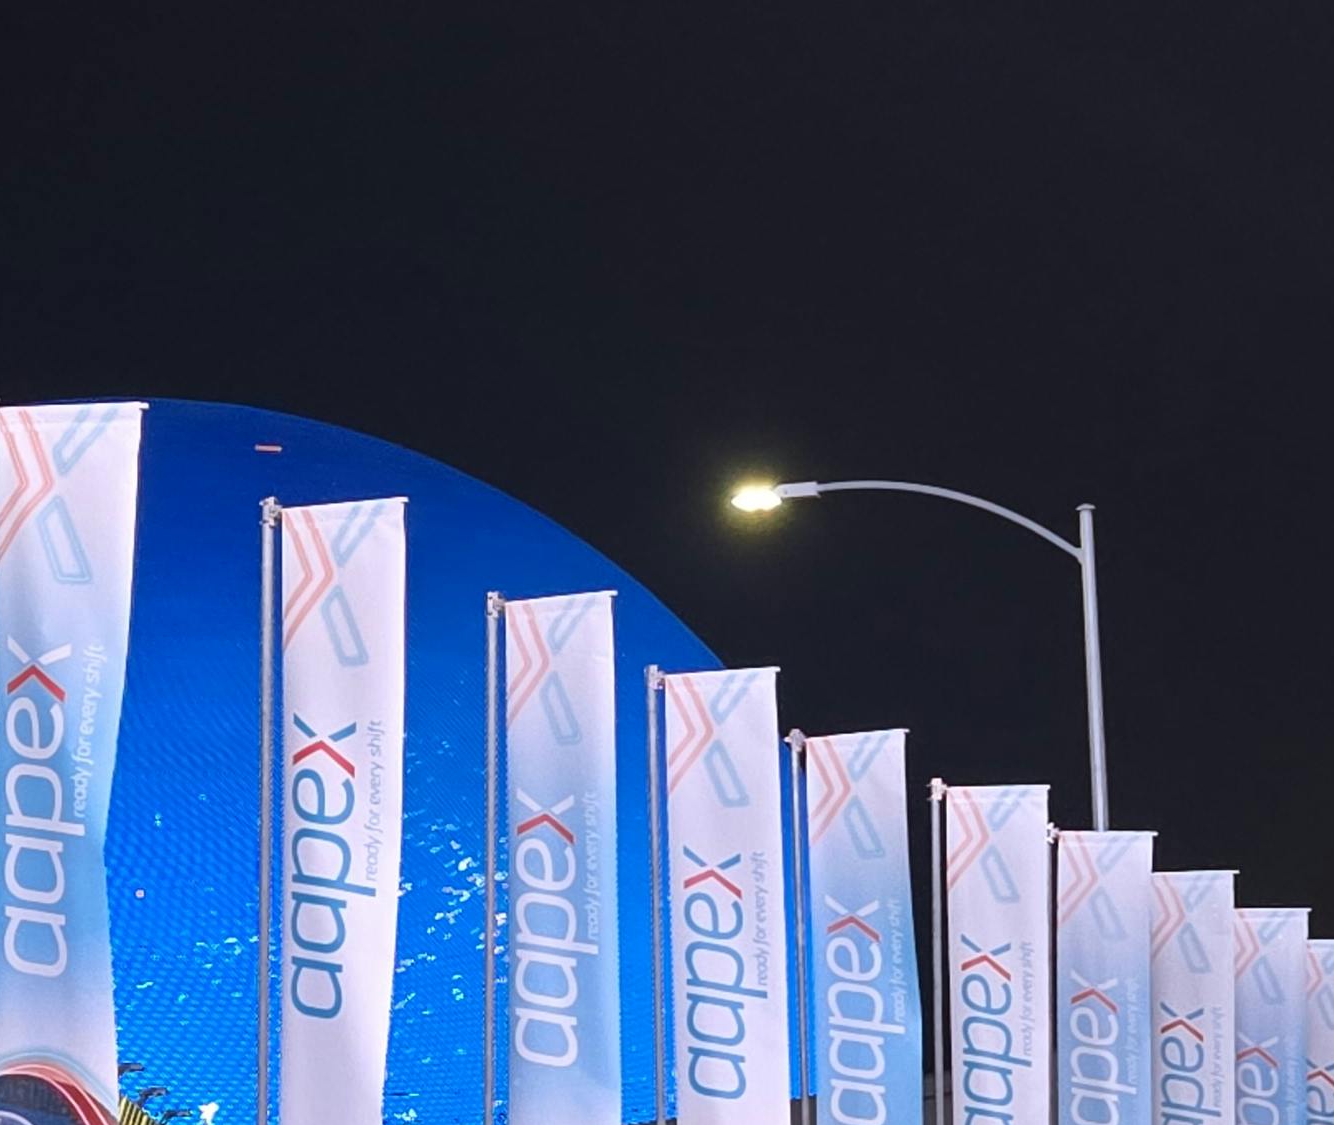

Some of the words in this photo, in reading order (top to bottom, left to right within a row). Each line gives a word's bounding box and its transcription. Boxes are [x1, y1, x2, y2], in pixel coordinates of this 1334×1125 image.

[82, 644, 107, 684] shift
[79, 687, 102, 736] every
[71, 736, 94, 765] for
[367, 719, 385, 757] shift
[3, 635, 85, 978] aapex
[70, 767, 93, 818] ready
[369, 761, 384, 805] every
[364, 809, 384, 833] for
[291, 712, 376, 1020] aapex
[363, 835, 383, 882] ready
[515, 788, 599, 1068] aapex
[683, 844, 768, 1100] aapex
